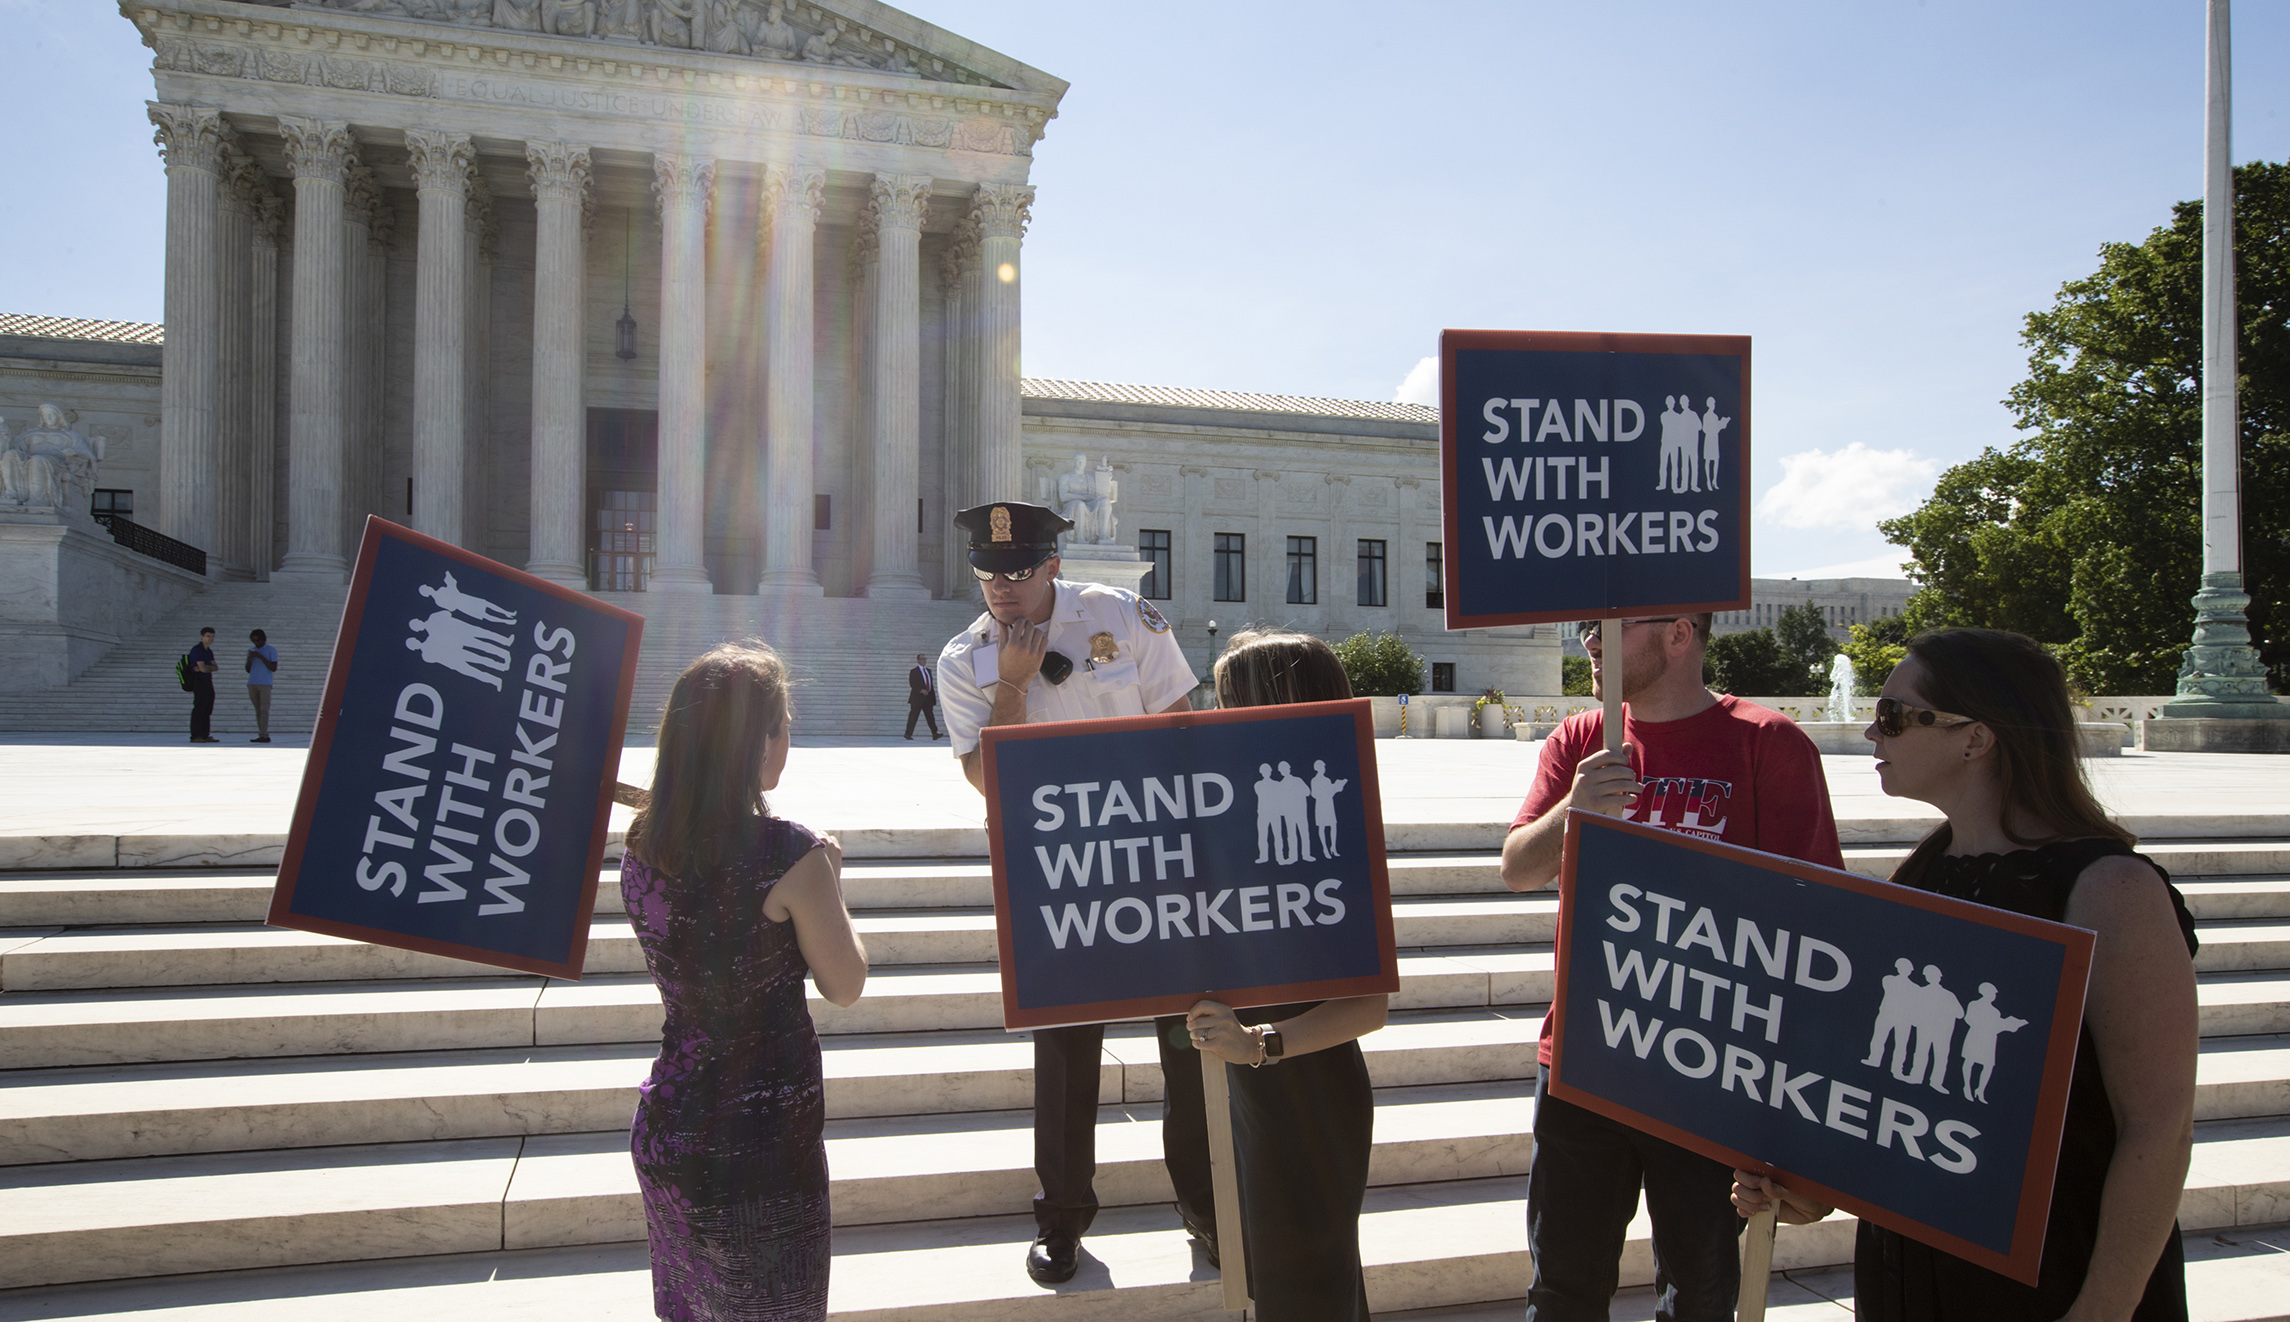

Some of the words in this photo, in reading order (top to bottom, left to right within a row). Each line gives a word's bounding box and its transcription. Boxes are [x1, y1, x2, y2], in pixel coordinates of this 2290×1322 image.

[456, 79, 539, 103] EQUAL
[544, 89, 640, 113] JUSTICE
[651, 98, 729, 122] UNDER
[737, 108, 782, 126] LAW
[1482, 397, 1645, 444] STAND
[1481, 456, 1609, 502] WITH
[1482, 509, 1719, 559] WORKERS
[356, 682, 444, 898] STAND
[477, 620, 576, 917] WORKERS
[417, 743, 496, 904] WITH
[1032, 772, 1234, 832] STAND
[1034, 833, 1195, 890] WITH
[1685, 829, 1722, 842] CAPITOL
[1040, 878, 1346, 950] WORKERS
[1605, 883, 1852, 992] STAND
[1602, 940, 1784, 1044] WITH
[1597, 998, 1982, 1174] WORKERS
